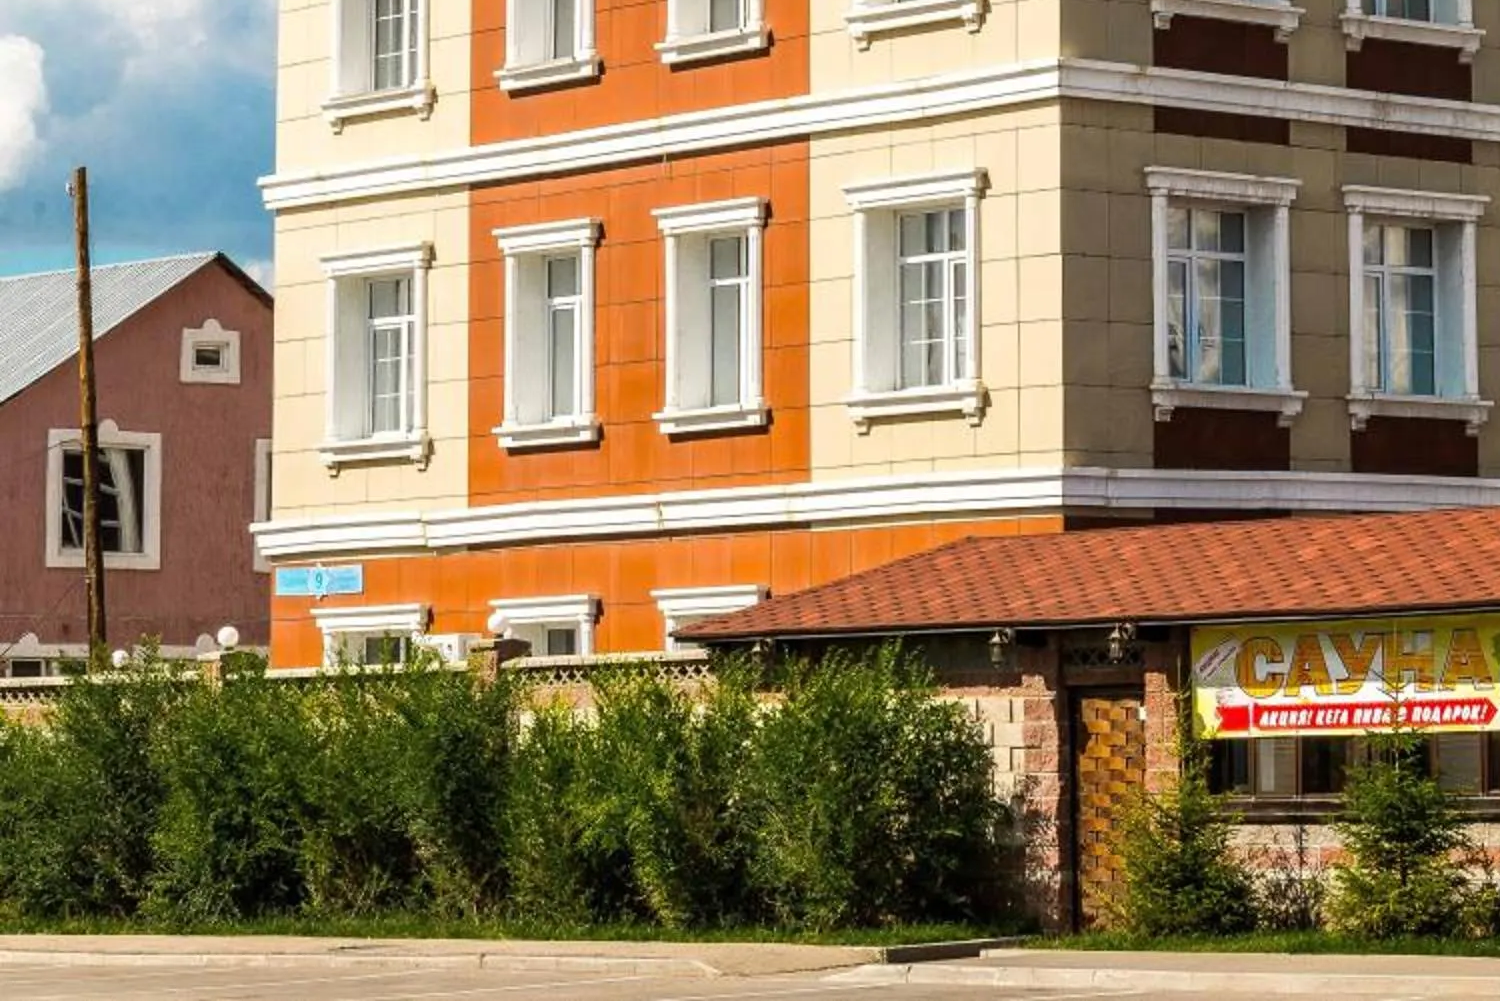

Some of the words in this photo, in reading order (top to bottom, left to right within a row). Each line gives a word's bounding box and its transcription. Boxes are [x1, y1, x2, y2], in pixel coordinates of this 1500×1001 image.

[1234, 628, 1495, 698] САУНА
[1259, 710, 1313, 727] АКЦИЯ!
[1315, 708, 1349, 726] КЕГА
[1353, 707, 1392, 724] ПИВА
[1411, 703, 1488, 723] ПОДАРОК!
